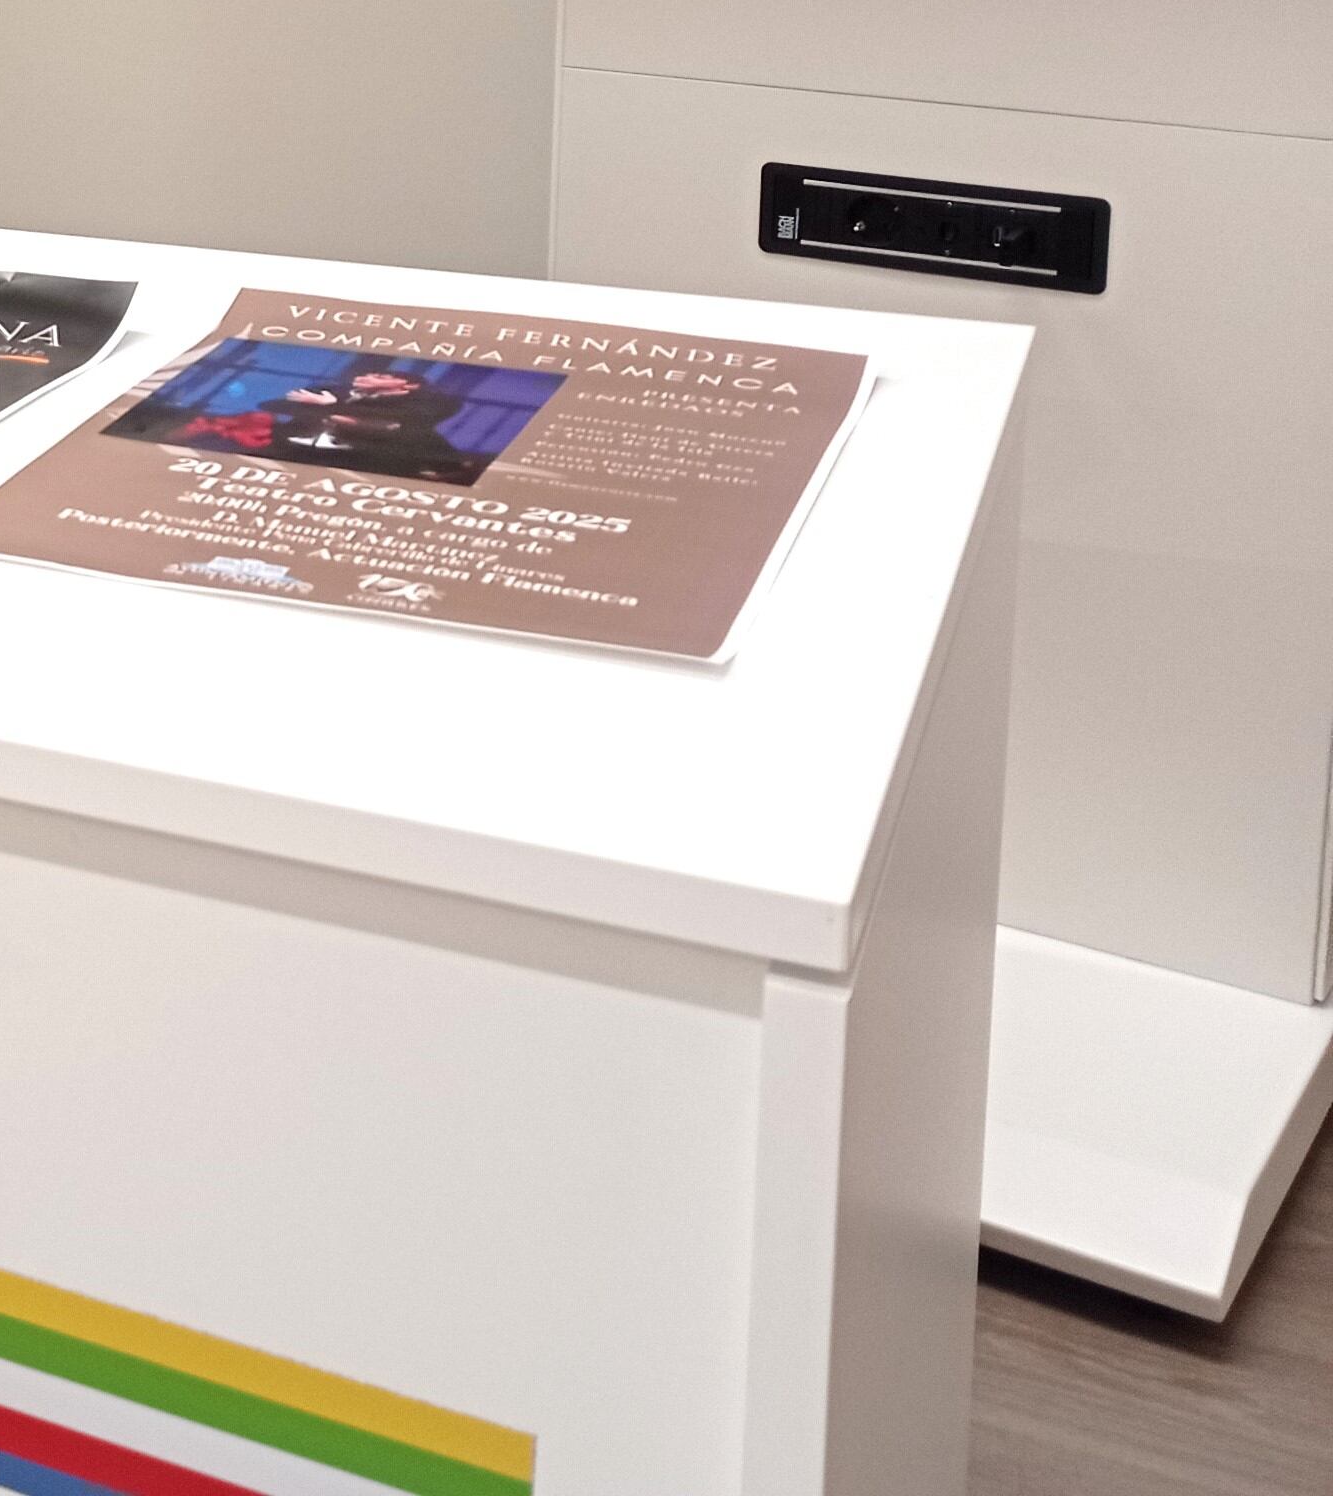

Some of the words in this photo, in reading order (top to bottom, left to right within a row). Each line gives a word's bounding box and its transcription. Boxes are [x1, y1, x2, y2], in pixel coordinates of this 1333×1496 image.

[261, 325, 502, 362] COMPAÑÍA
[533, 354, 798, 396] FLAMENCA
[289, 305, 475, 338] VICENTE
[496, 327, 779, 371] FERNÁNDEZ
[168, 457, 223, 476] 20
[229, 466, 298, 486] DE
[303, 476, 510, 515] AGOSTO
[519, 506, 632, 533] 2025
[196, 475, 337, 507] Teatro
[351, 498, 577, 543] Cervantes
[481, 572, 639, 607] Flamenca
